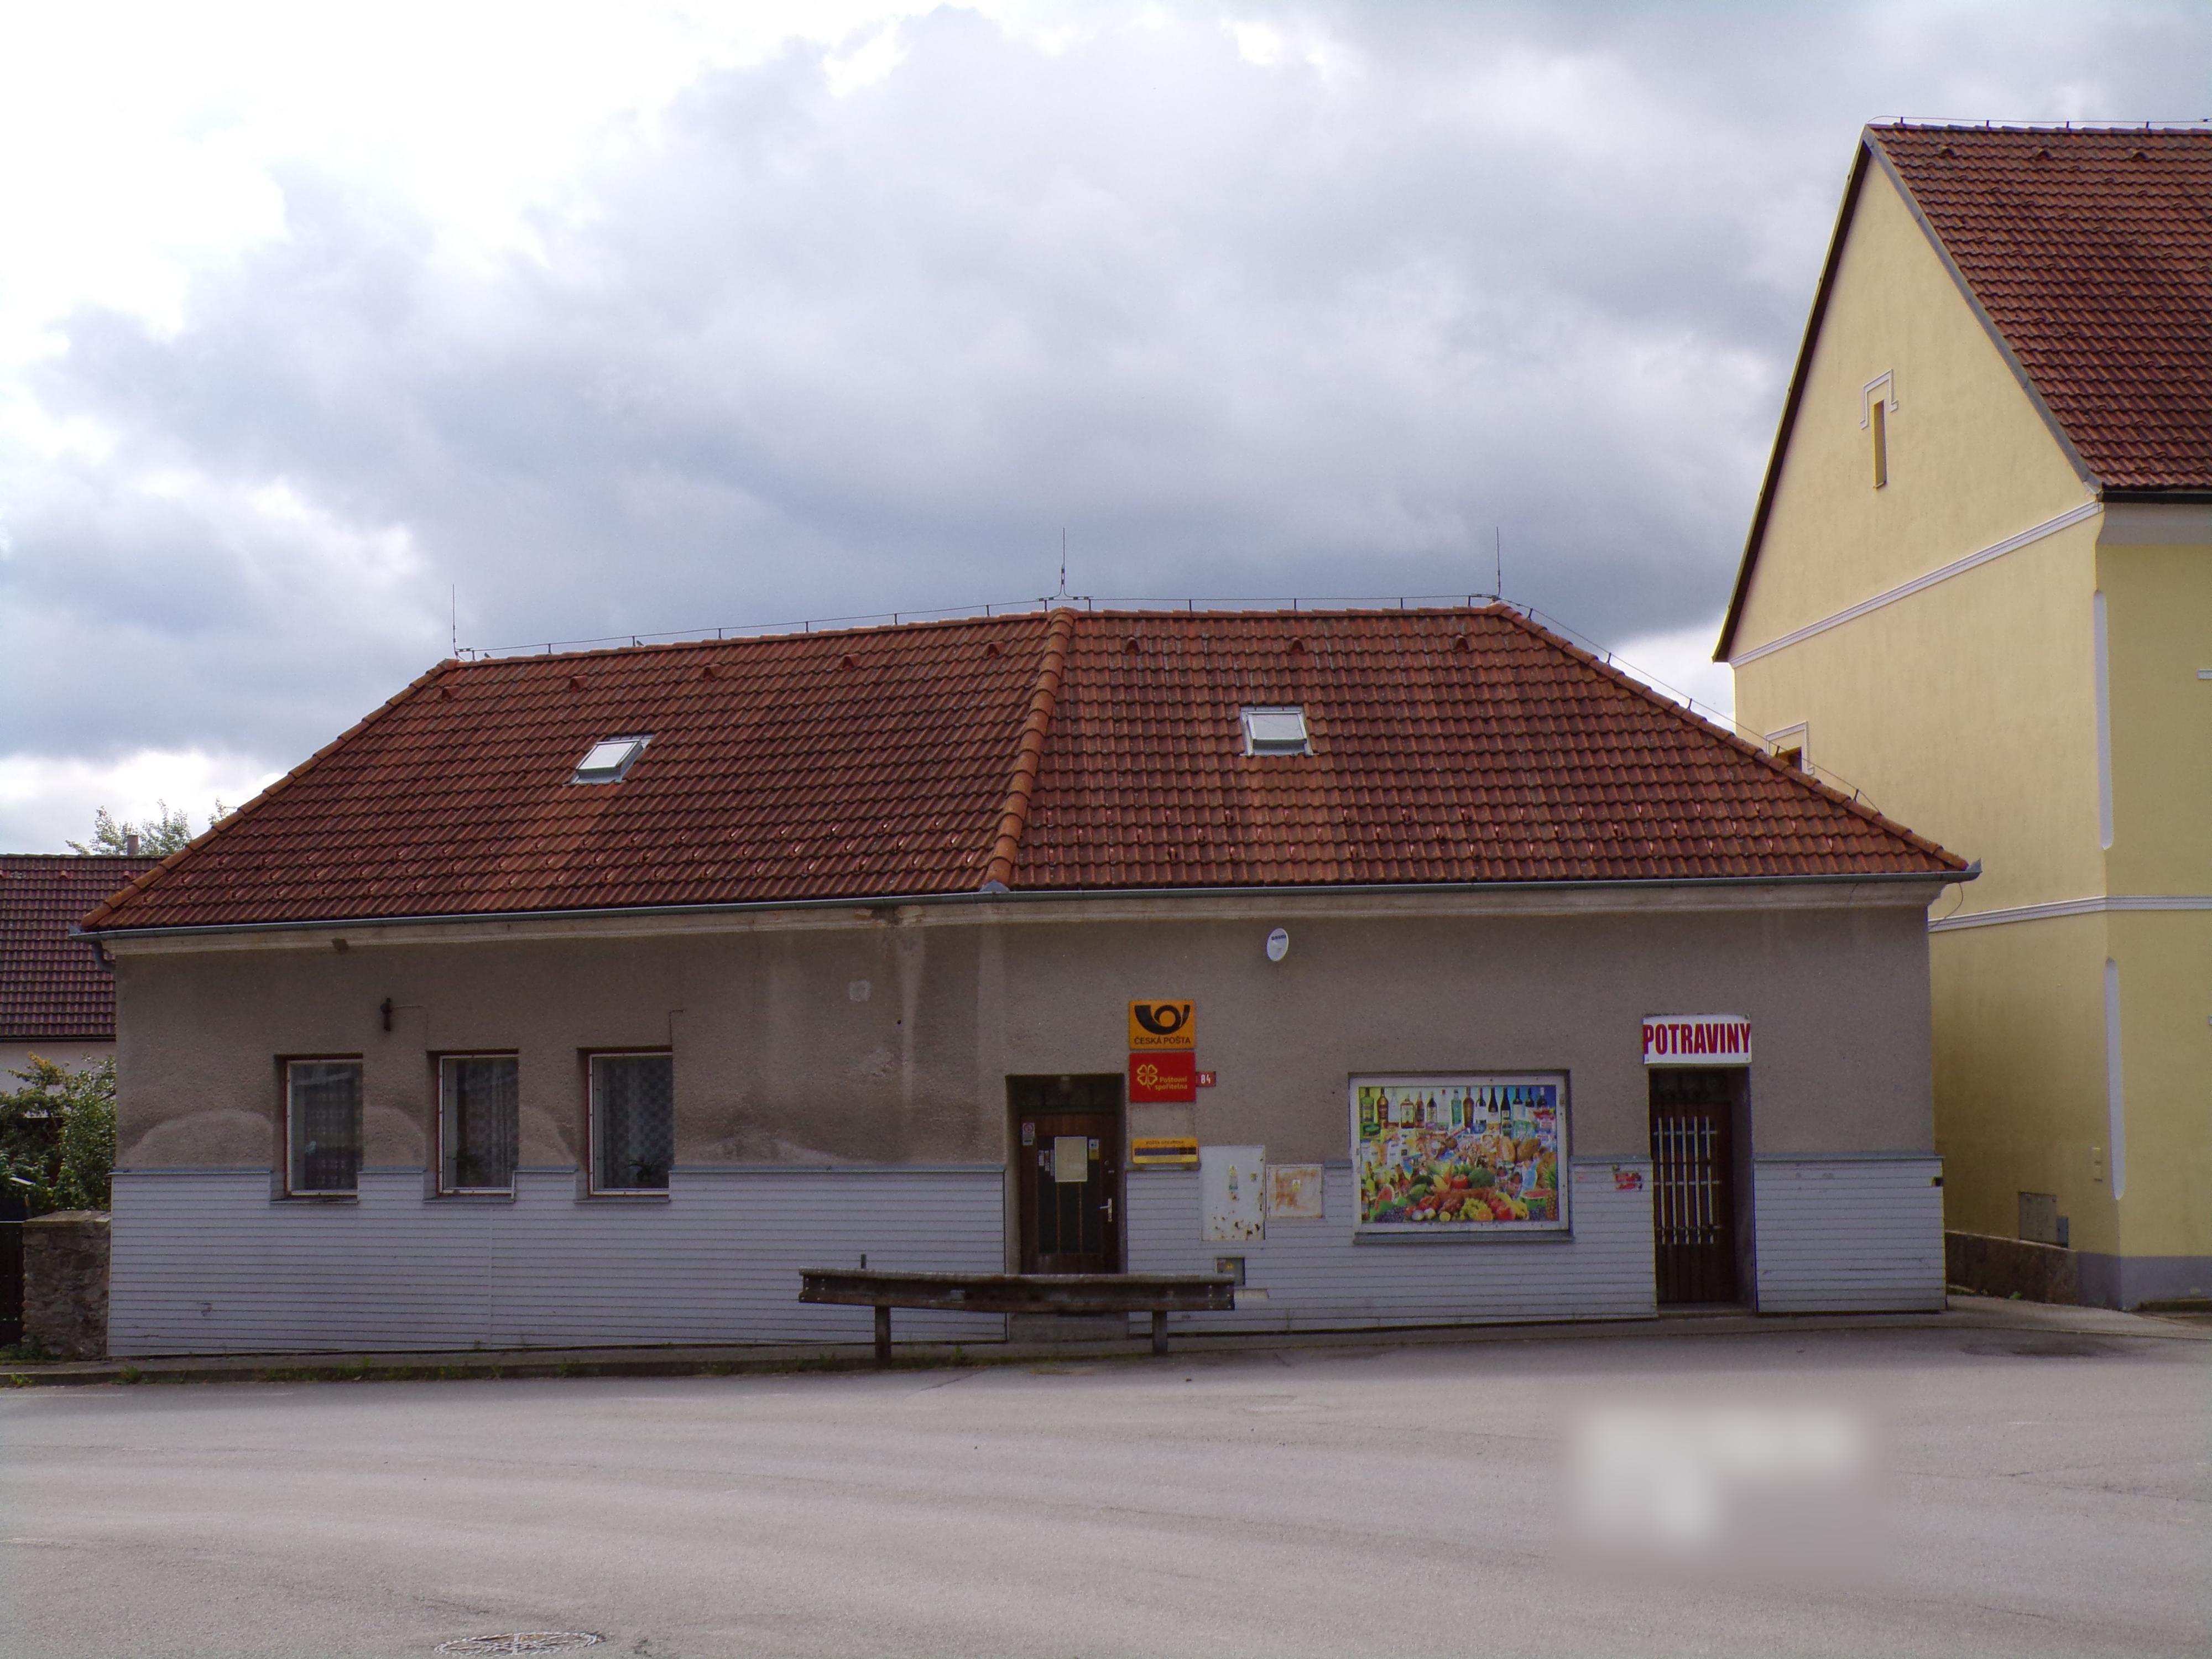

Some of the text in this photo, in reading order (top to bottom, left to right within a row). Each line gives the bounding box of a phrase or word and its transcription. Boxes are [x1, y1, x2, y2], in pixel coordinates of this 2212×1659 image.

[1134, 1036, 1191, 1045] ČESKÁ POŠTA
[1643, 1024, 1751, 1055] POTRAVINY
[1201, 1074, 1211, 1084] 84
